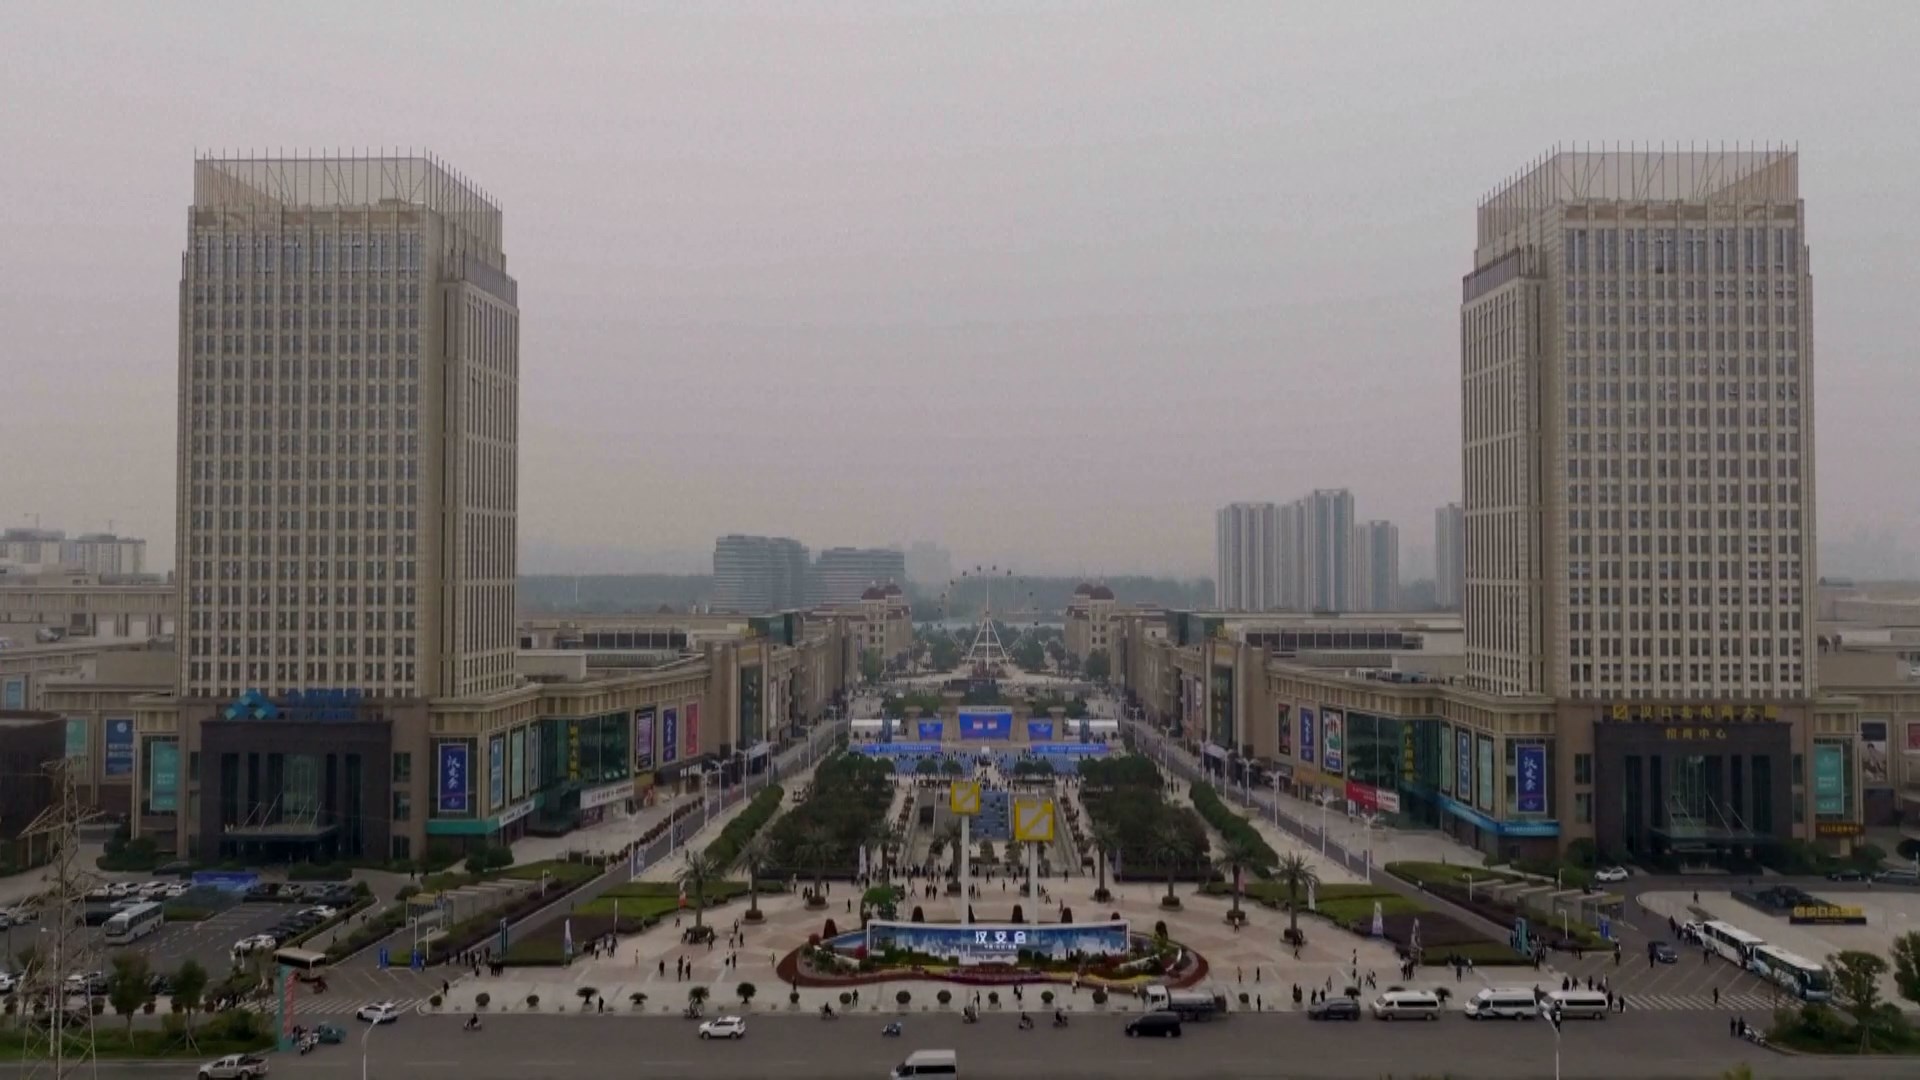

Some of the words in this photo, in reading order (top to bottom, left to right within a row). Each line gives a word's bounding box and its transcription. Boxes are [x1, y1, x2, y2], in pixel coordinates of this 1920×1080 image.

[1665, 727, 1727, 740] 招商中心
[975, 930, 1026, 945] 汉交会
